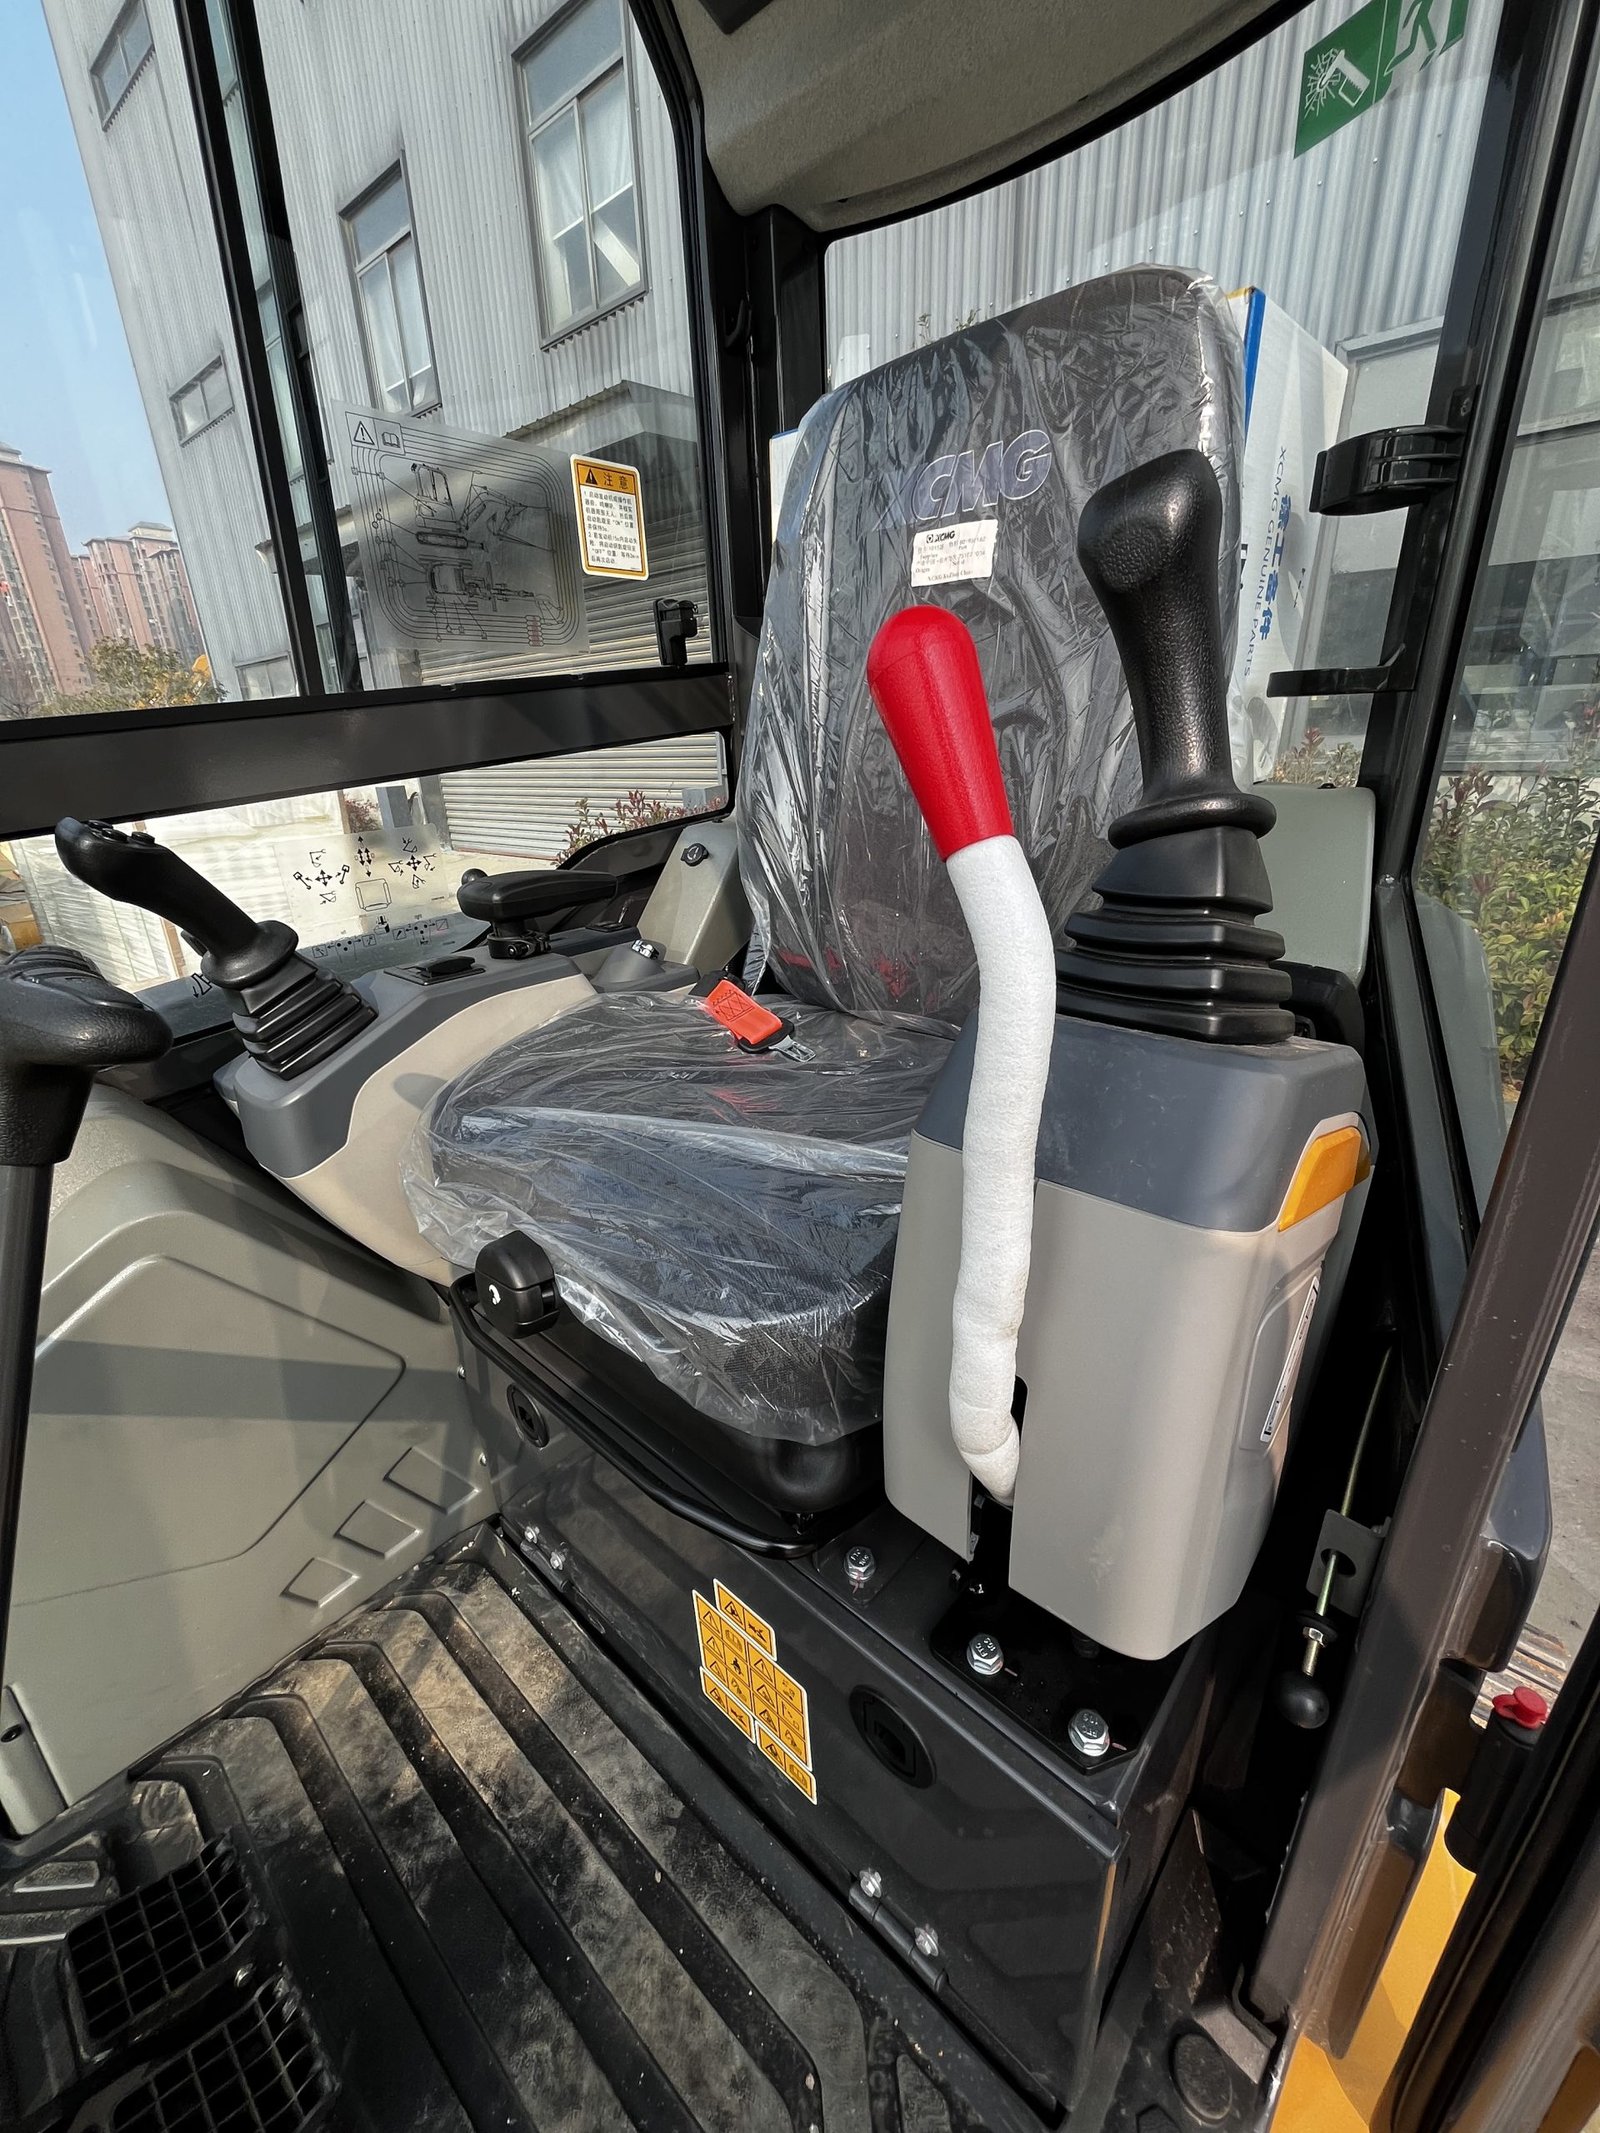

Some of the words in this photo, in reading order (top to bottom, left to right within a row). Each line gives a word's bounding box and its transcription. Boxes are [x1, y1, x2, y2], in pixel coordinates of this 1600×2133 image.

[603, 472, 629, 490] 注意
[872, 429, 1052, 531] XCMG
[1271, 446, 1288, 514] XCMG
[934, 530, 955, 543] XCMG
[1255, 519, 1275, 610] GENUINE
[1260, 494, 1292, 640] 徐工备件
[1244, 618, 1260, 677] PARTS
